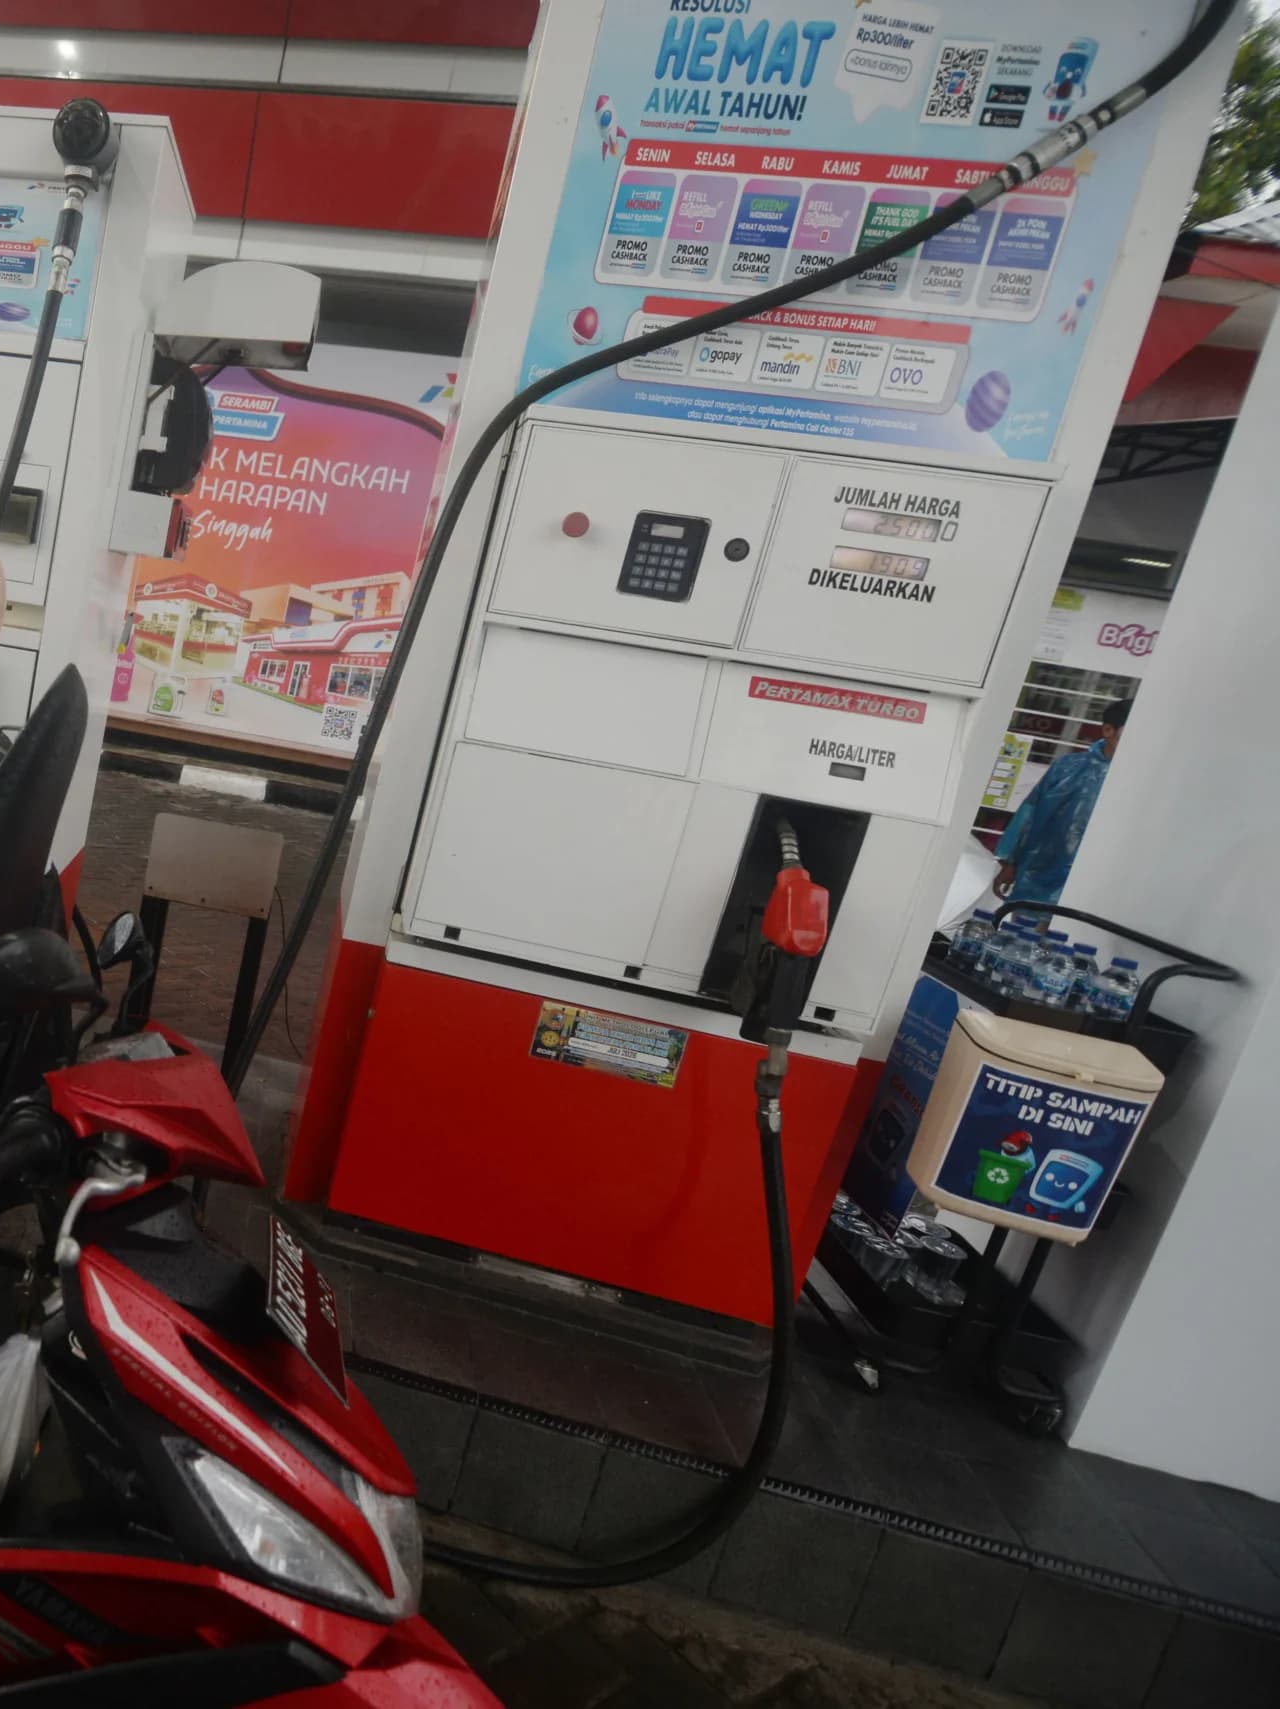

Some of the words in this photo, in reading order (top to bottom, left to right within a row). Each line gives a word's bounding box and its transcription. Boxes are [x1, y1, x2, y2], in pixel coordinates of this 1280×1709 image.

[862, 13, 888, 26] HARGA
[888, 17, 909, 30] LEBIH
[909, 21, 935, 35] HEMAT
[856, 27, 915, 50] Rp300/liter
[654, 16, 836, 88] HEMAT
[644, 87, 711, 116] AWAL
[719, 91, 808, 121] TAHUN!
[636, 147, 671, 163] SENIN
[694, 151, 736, 168] SELASA
[761, 156, 795, 172] RABU
[822, 160, 861, 176] KAMIS
[886, 164, 929, 181] JUMAT
[1017, 173, 1071, 192] INGGU
[616, 239, 648, 251] PROMO
[677, 244, 709, 256] PROMO
[611, 250, 648, 262] CASHBACK
[671, 255, 709, 267] CASHBACK
[737, 251, 771, 264] PROMO
[800, 255, 834, 267] PROMO
[732, 263, 771, 275] CASHBACK
[928, 265, 964, 278] PROMO
[923, 276, 963, 289] CASHBACK
[996, 272, 1033, 285] PROMO
[990, 283, 1032, 296] CASHBACK
[773, 312, 782, 323] &
[783, 313, 816, 327] BONUS
[817, 316, 849, 329] SETIAP
[710, 349, 742, 365] gopay
[760, 359, 800, 376] mandiri
[837, 359, 862, 377] BNI
[890, 366, 923, 385] OVO
[220, 394, 272, 410] SERAMBI
[235, 449, 411, 495] MELANGKAH
[199, 476, 329, 516] HARAPAN
[834, 486, 902, 511] JUMLAH
[903, 494, 961, 519] HARGA
[191, 508, 274, 552] Singgah
[808, 568, 936, 603] DIKELUARKAN
[1098, 622, 1160, 656] Brig
[754, 681, 852, 709] PERTAMAX
[855, 698, 921, 720] TURBO
[808, 738, 896, 768] HARGA/LITER
[986, 1072, 1043, 1101] TITIP
[1046, 1092, 1142, 1126] SAMPAH
[1018, 1105, 1043, 1124] DI
[1047, 1113, 1094, 1137] SINI
